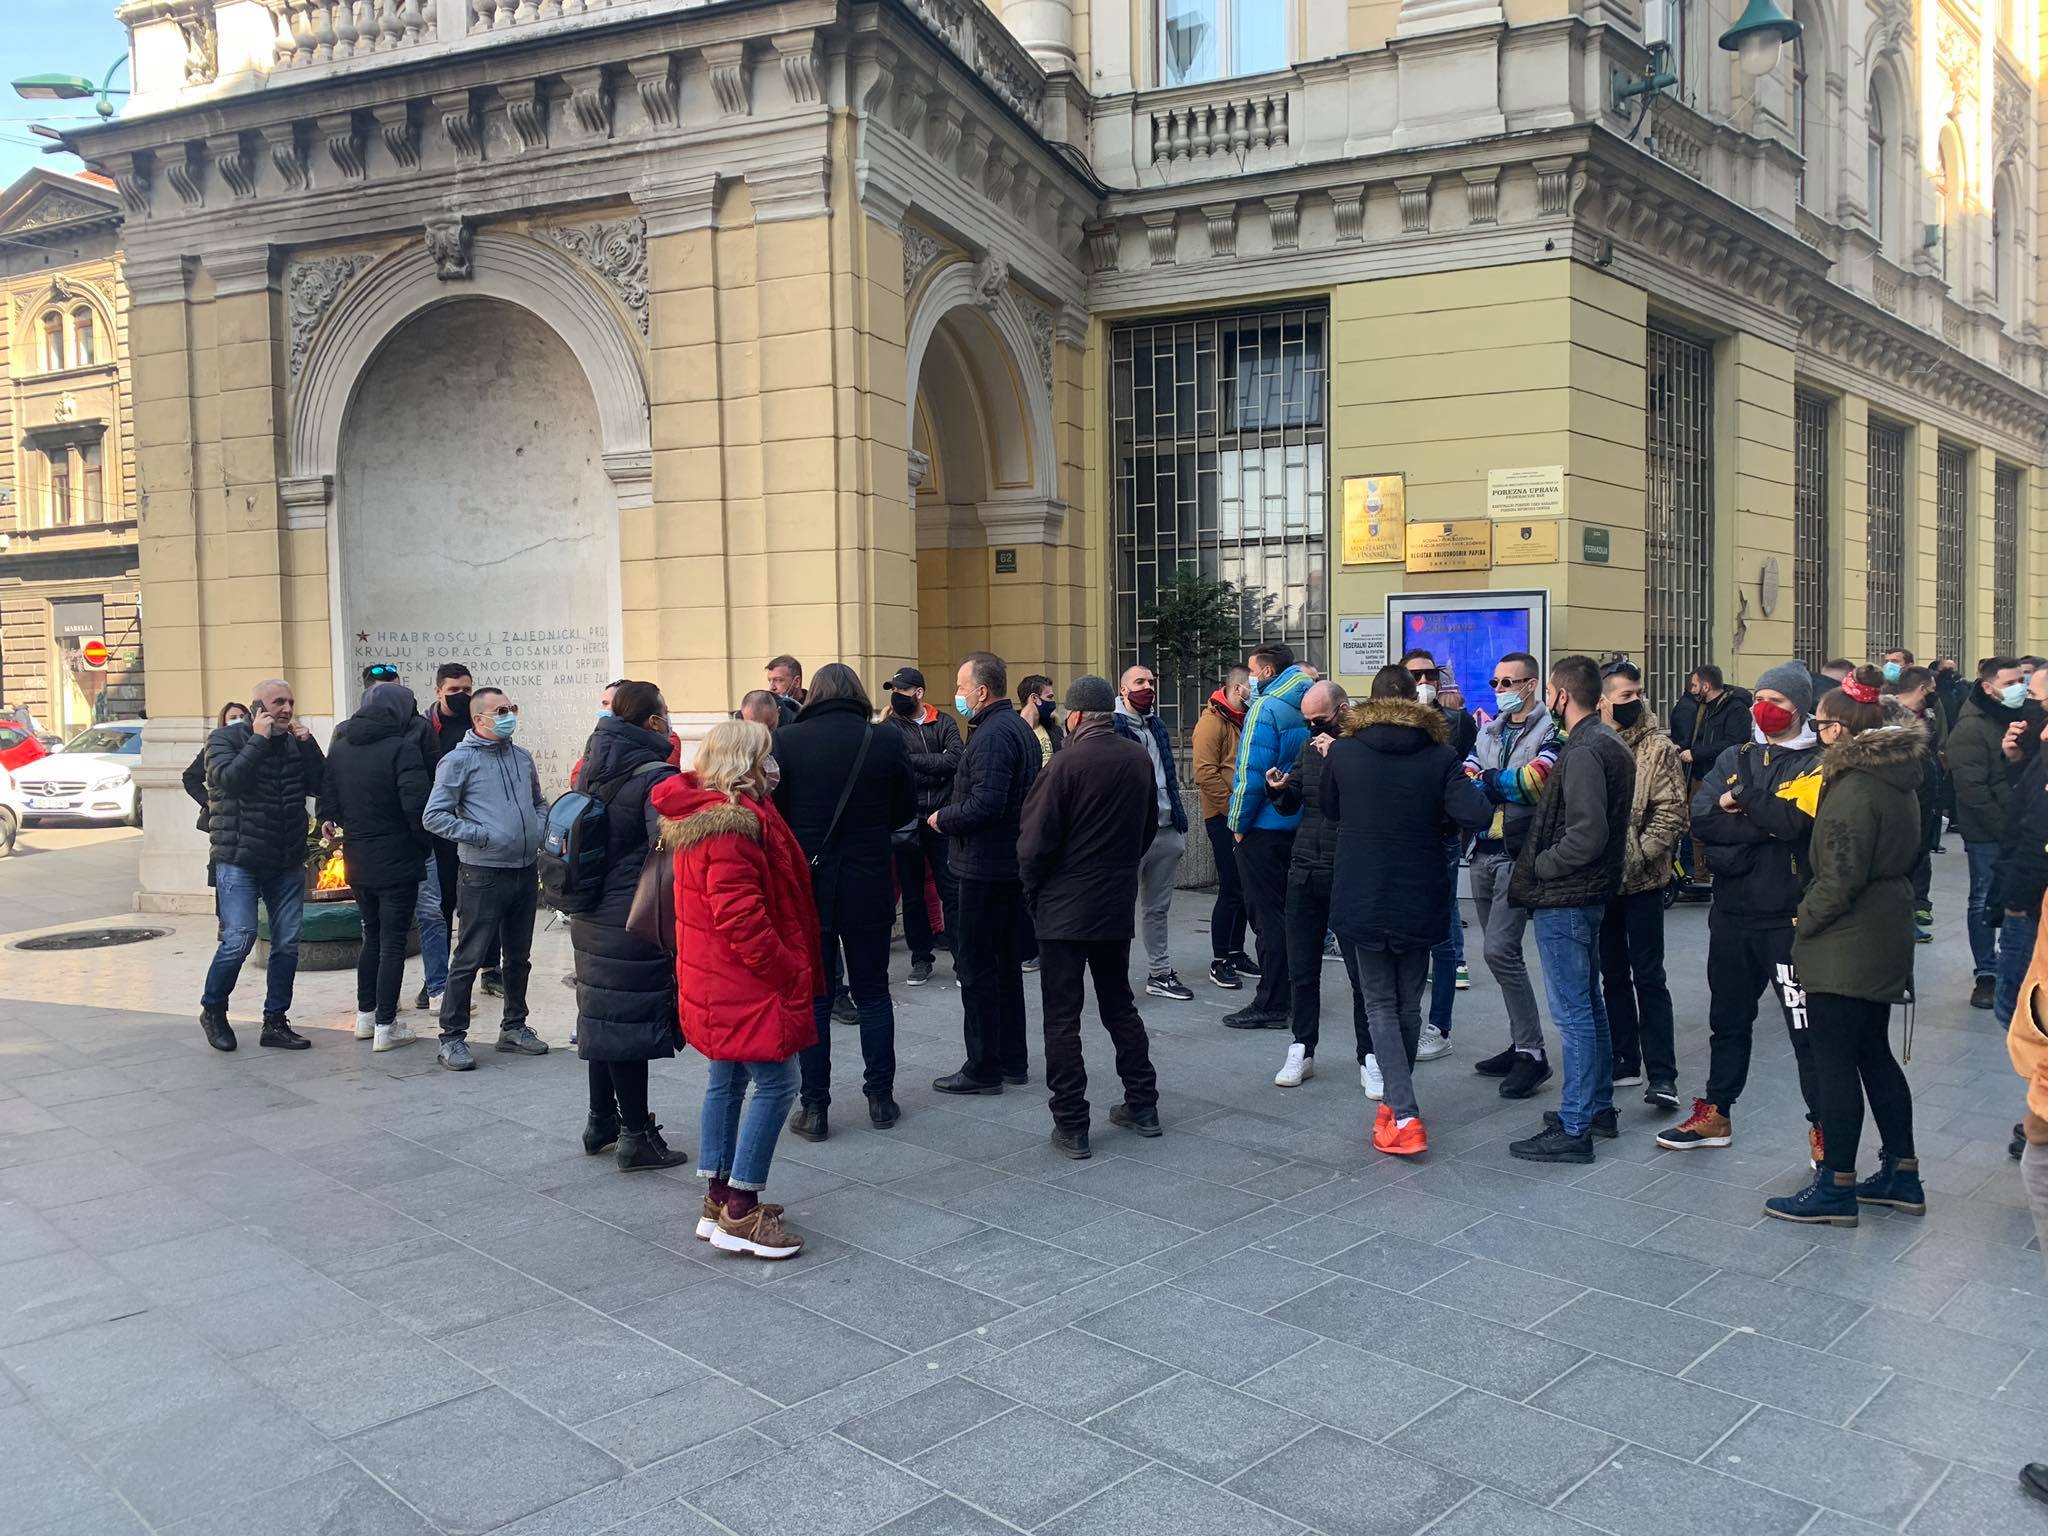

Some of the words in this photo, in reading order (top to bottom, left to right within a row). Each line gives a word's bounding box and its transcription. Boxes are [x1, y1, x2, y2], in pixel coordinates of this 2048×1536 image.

[1492, 488, 1527, 496] POREZNA
[1529, 486, 1559, 494] UPRAVA
[1368, 641, 1383, 649] ZAVOD
[355, 647, 412, 658] KRVLJU
